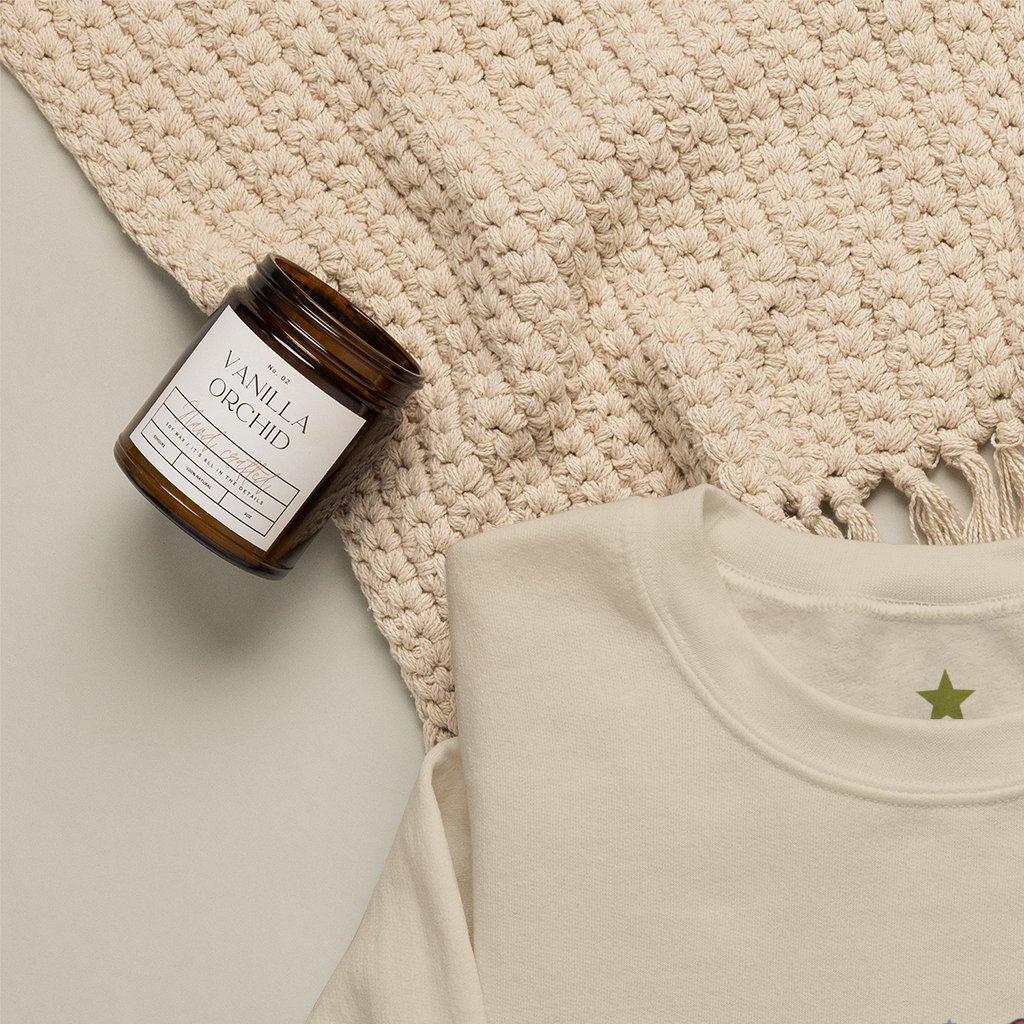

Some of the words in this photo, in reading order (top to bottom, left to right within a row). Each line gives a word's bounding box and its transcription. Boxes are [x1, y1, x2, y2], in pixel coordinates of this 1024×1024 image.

[209, 377, 290, 450] ORCHID
[224, 349, 309, 434] VANILLA
[266, 363, 279, 377] No.
[280, 375, 291, 385] 02
[165, 421, 175, 431] SOY
[175, 431, 186, 442] WAX
[190, 446, 202, 458] IT'S
[203, 458, 214, 468] ALL
[225, 475, 237, 486] THE
[238, 485, 264, 505] DETAILS
[175, 400, 227, 453] Hand
[220, 449, 281, 495] crafted
